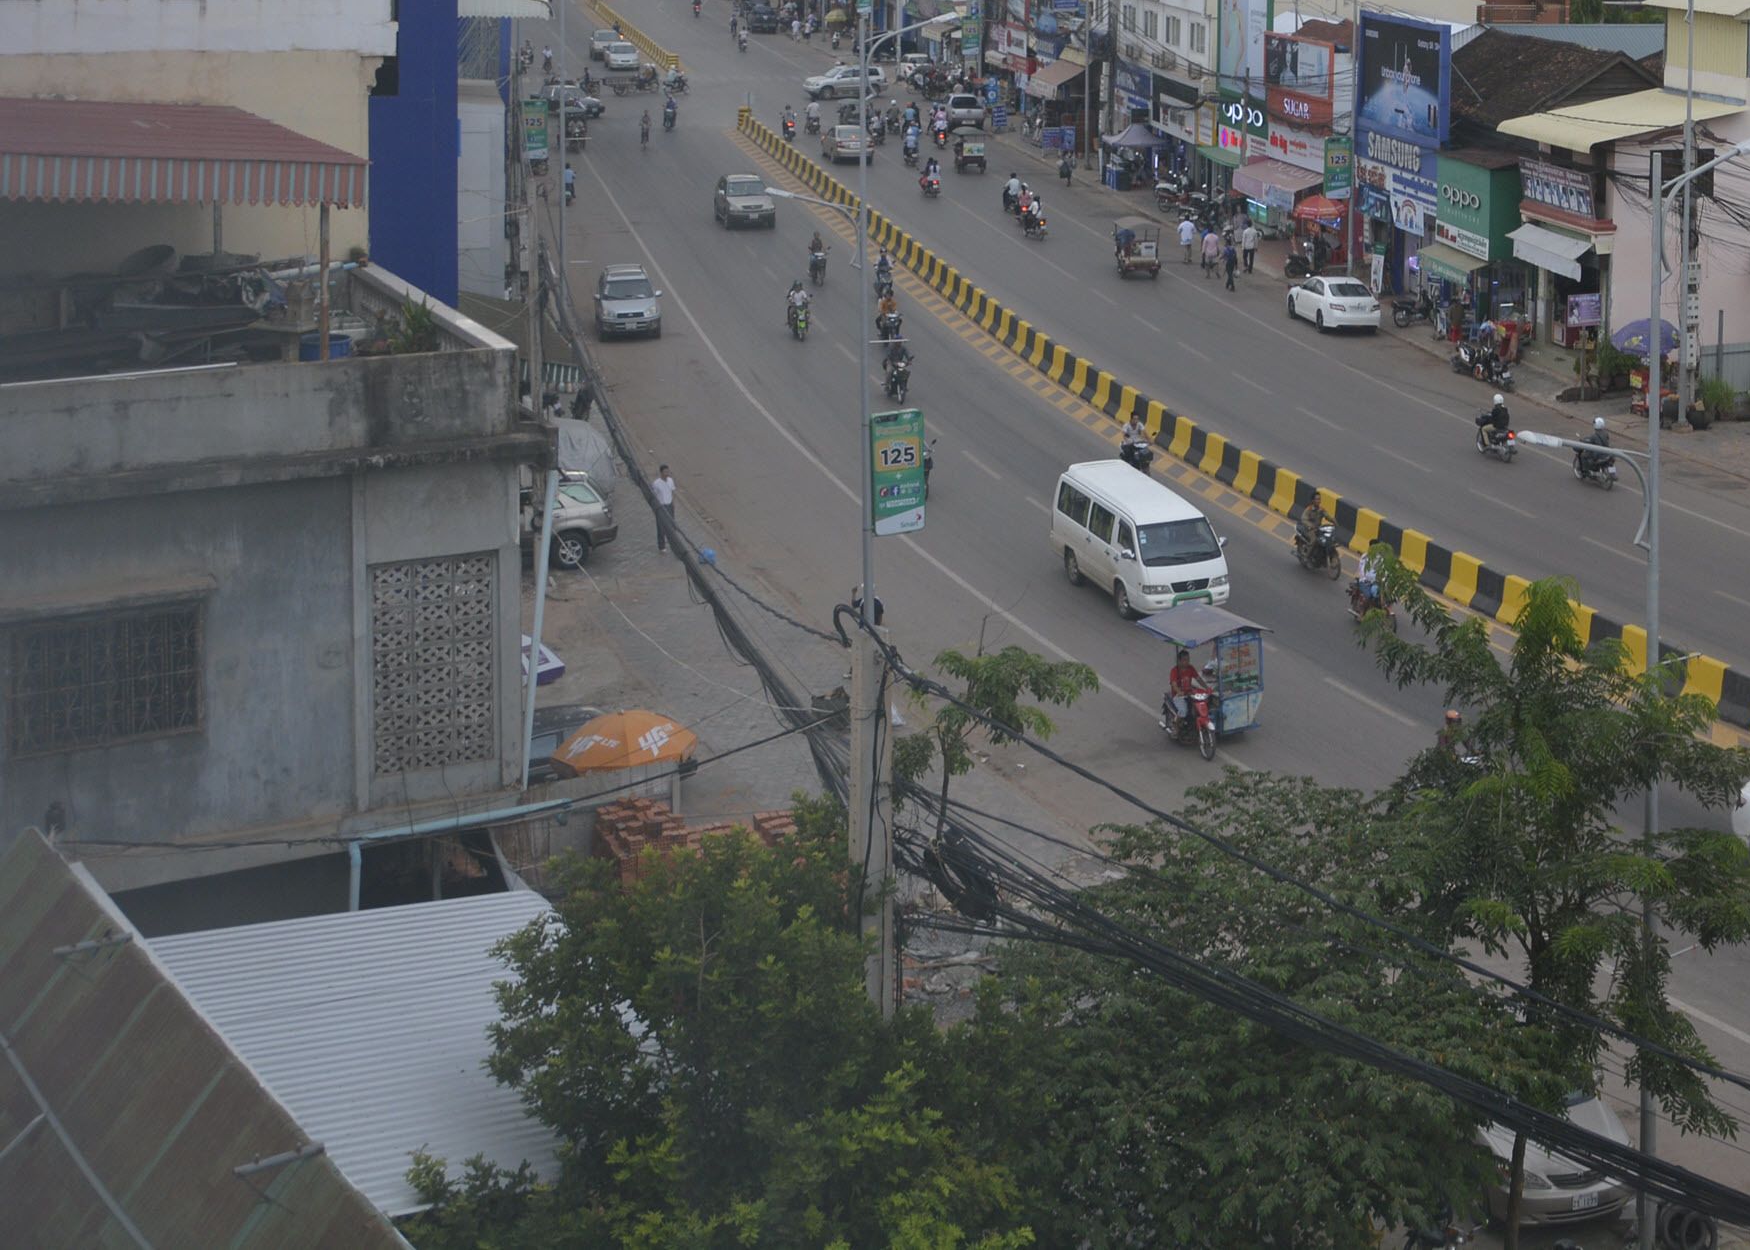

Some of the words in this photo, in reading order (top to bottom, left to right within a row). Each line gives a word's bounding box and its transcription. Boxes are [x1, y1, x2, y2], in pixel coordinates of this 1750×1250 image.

[1283, 97, 1310, 120] SUGAR
[1330, 155, 1347, 165] 125
[1368, 131, 1421, 173] SAMSUNG
[1441, 184, 1480, 209] oppo
[881, 446, 915, 465] 125
